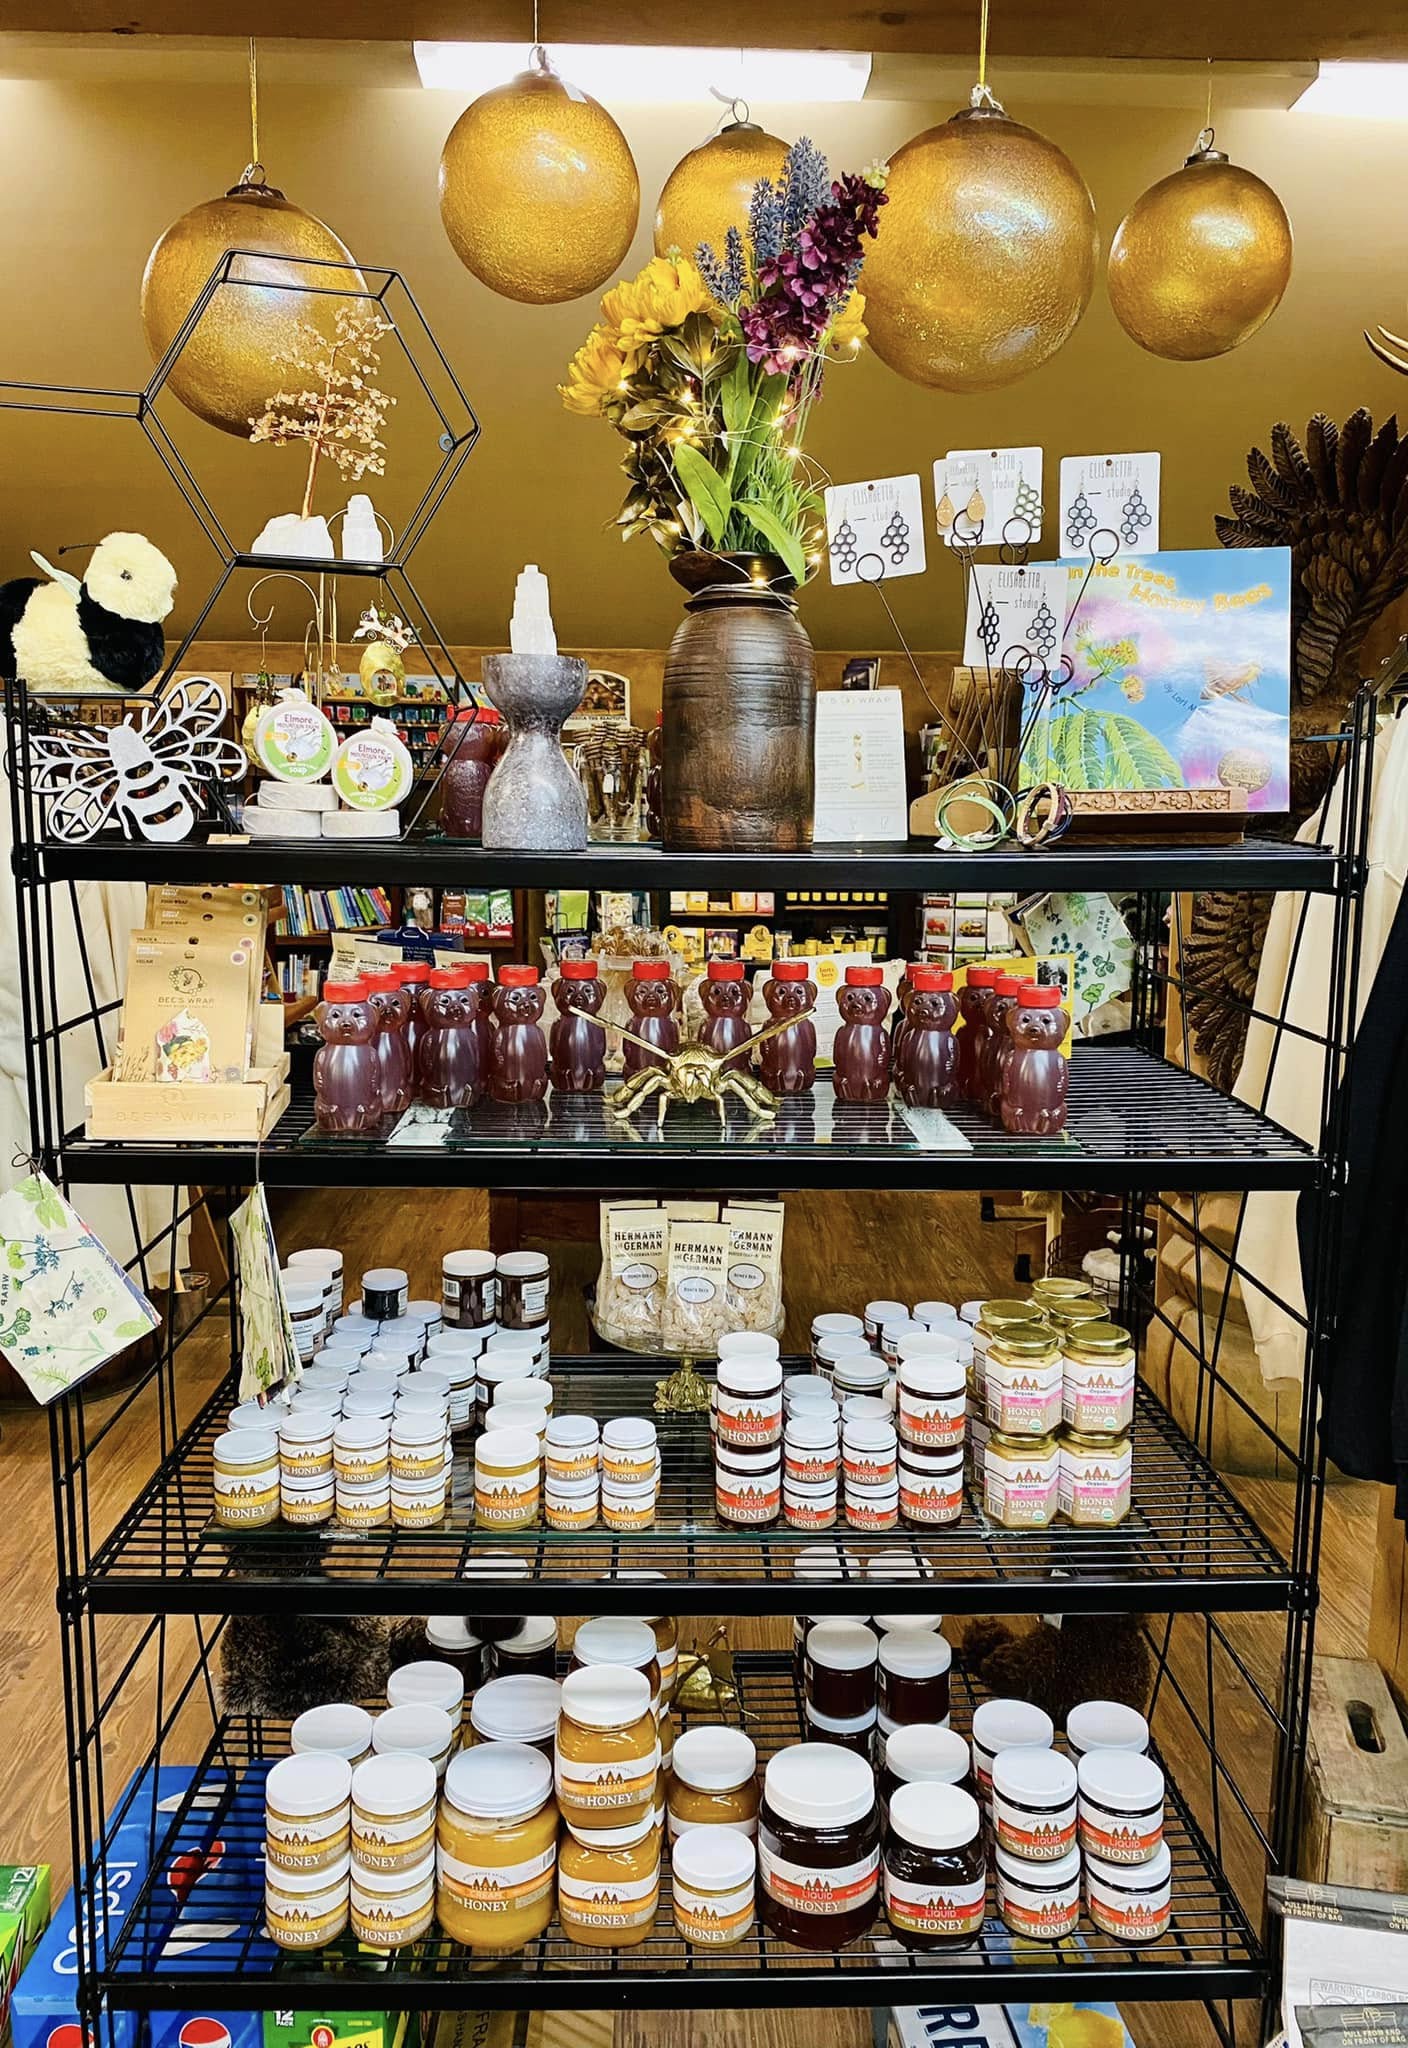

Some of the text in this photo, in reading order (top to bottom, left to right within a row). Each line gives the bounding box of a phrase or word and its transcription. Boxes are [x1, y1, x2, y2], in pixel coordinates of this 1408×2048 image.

[1067, 566, 1084, 579] In
[1014, 592, 1039, 609] studio
[1128, 583, 1273, 617] Honey Bees
[284, 713, 313, 724] Elmore
[358, 743, 386, 755] Elmore
[180, 1111, 233, 1122] WRAP
[614, 1231, 663, 1242] HERMANN
[623, 1241, 663, 1251] GERMAN
[674, 1243, 723, 1254] HERMANN
[1007, 1407, 1042, 1417] HONEY
[1082, 1406, 1116, 1415] HONEY
[735, 1421, 765, 1431] LIQUID
[921, 1421, 952, 1432] LIQUID
[728, 1430, 772, 1442] HONEY
[913, 1431, 957, 1445] HONEY
[289, 1465, 323, 1475] HONEY
[395, 1467, 427, 1478] HONEY
[566, 1468, 595, 1479] HONEY
[343, 1472, 376, 1482] HONEY
[611, 1472, 641, 1481] HONEY
[798, 1471, 828, 1481] HONEY
[852, 1473, 882, 1483] HONEY
[490, 1499, 521, 1507] CREAM
[736, 1497, 766, 1507] LIQUID
[917, 1497, 948, 1507] LIQUID
[1011, 1500, 1046, 1510] HONEY
[1080, 1497, 1114, 1507] HONEY
[221, 1505, 267, 1519] HONEY
[289, 1511, 321, 1521] HONEY
[484, 1506, 528, 1520] HONEY
[728, 1507, 772, 1520] HONEY
[795, 1513, 817, 1521] LIQUID
[855, 1513, 878, 1521] LIQUID
[910, 1506, 954, 1521] HONEY
[344, 1516, 377, 1526] HONEY
[403, 1516, 434, 1526] HONEY
[550, 1520, 580, 1529] HONEY
[611, 1520, 642, 1529] HONEY
[791, 1518, 821, 1528] HONEY
[851, 1518, 881, 1529] HONEY
[594, 1785, 626, 1793] CREAM
[587, 1793, 633, 1807] HONEY
[1031, 1835, 1062, 1846] LIQUID
[1109, 1839, 1141, 1849] LIQUID
[1023, 1842, 1067, 1857] HONEY
[1101, 1847, 1148, 1861] HONEY
[276, 1853, 321, 1867] HONEY
[356, 1851, 398, 1868] HONEY
[802, 1890, 833, 1900] LIQUID
[463, 1898, 509, 1912] HONEY
[589, 1904, 622, 1913] CREAM
[795, 1898, 840, 1912] HONEY
[1284, 1900, 1340, 1914] PULL FROM END
[582, 1913, 629, 1925] HONEY
[925, 1909, 957, 1918] LIQUID
[1038, 1912, 1068, 1924] LIQUID
[1281, 1906, 1343, 1922] ON FRONT OF BAG
[690, 1917, 721, 1927] CREAM
[917, 1918, 964, 1930] HONEY
[1123, 1915, 1154, 1926] LIQUID
[1389, 1921, 1401, 1929] ON
[684, 1924, 729, 1941] HONEY
[1030, 1920, 1072, 1936] HONEY
[1115, 1922, 1160, 1937] HONEY
[276, 1928, 321, 1943] HONEY
[360, 1926, 405, 1942] HONEY
[1320, 1983, 1362, 1997] WARNING
[1343, 2030, 1362, 2038] PULL
[1385, 2028, 1401, 2036] END
[1343, 2038, 1353, 2046] ON
[1353, 2037, 1378, 2046] FRONT
[1391, 2034, 1407, 2043] BAG
